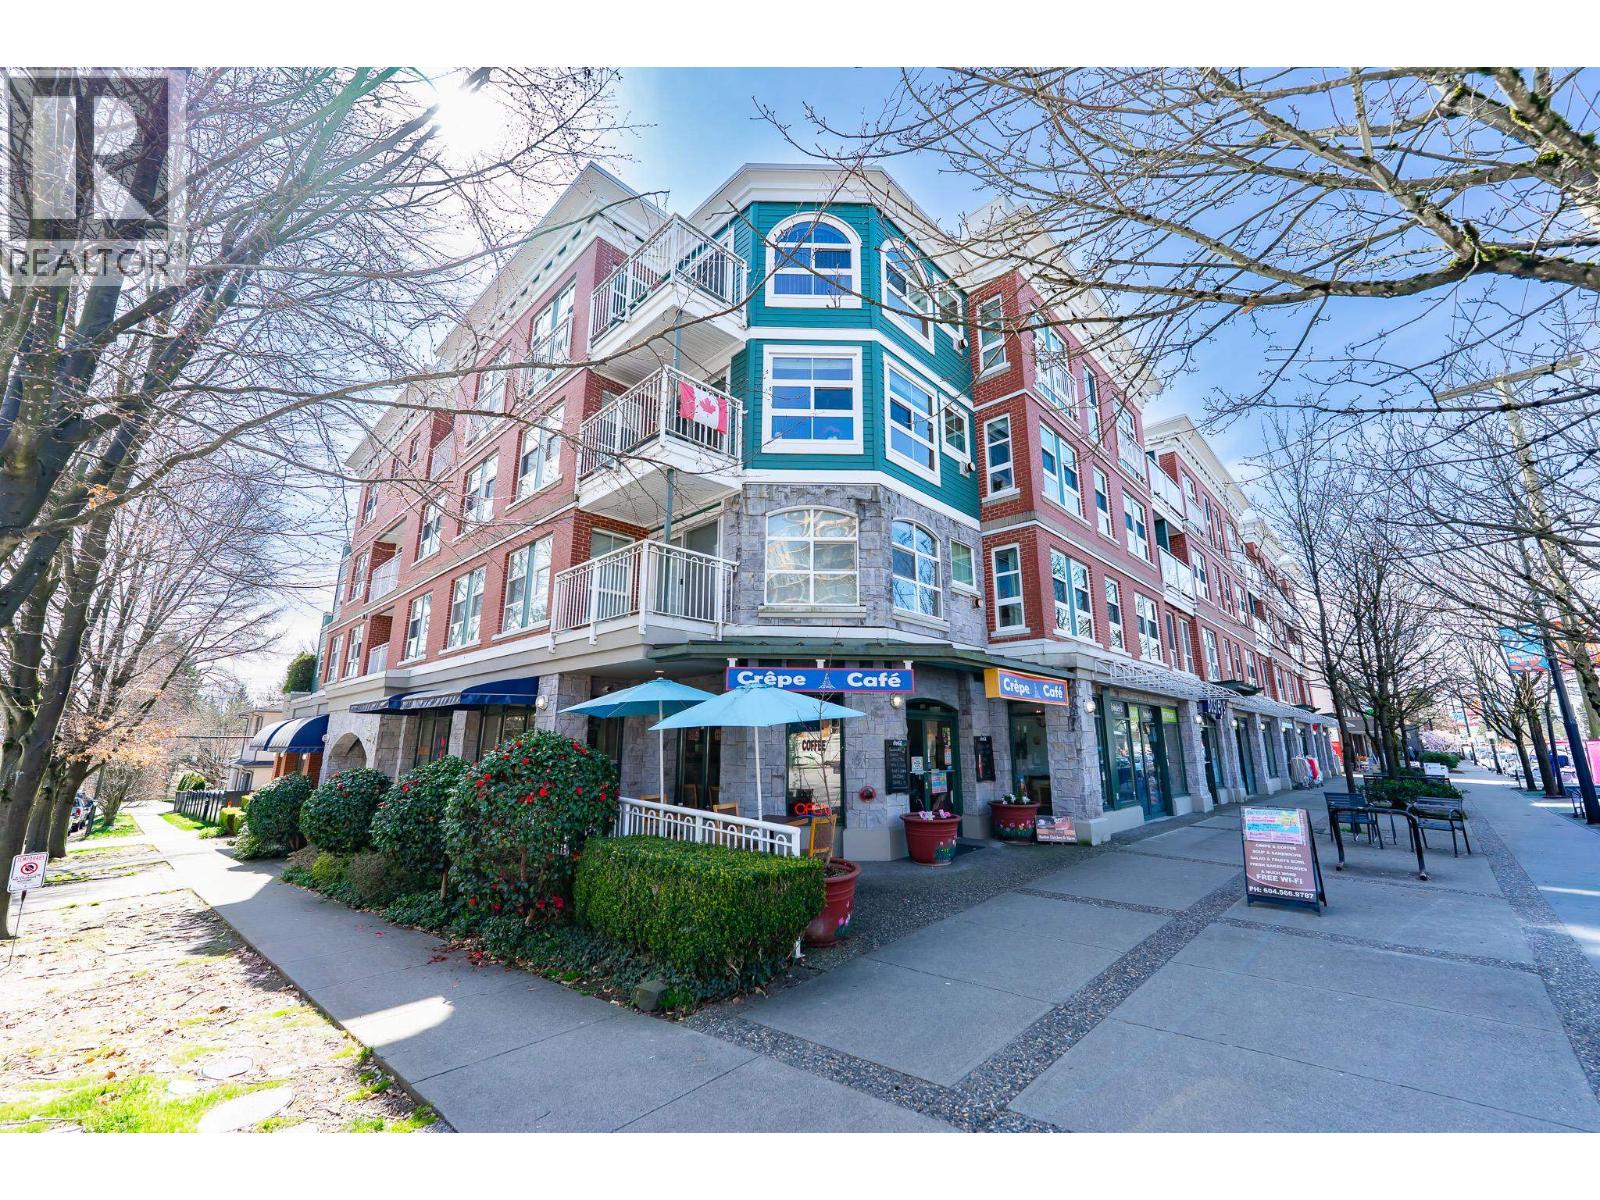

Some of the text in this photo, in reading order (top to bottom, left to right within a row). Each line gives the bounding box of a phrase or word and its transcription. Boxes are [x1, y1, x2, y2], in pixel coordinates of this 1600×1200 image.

[737, 671, 901, 688] Crêpe Café
[1003, 677, 1063, 698] Crêpe Café
[802, 740, 826, 751] COFFEE
[1256, 874, 1303, 885] FREE WI-FI
